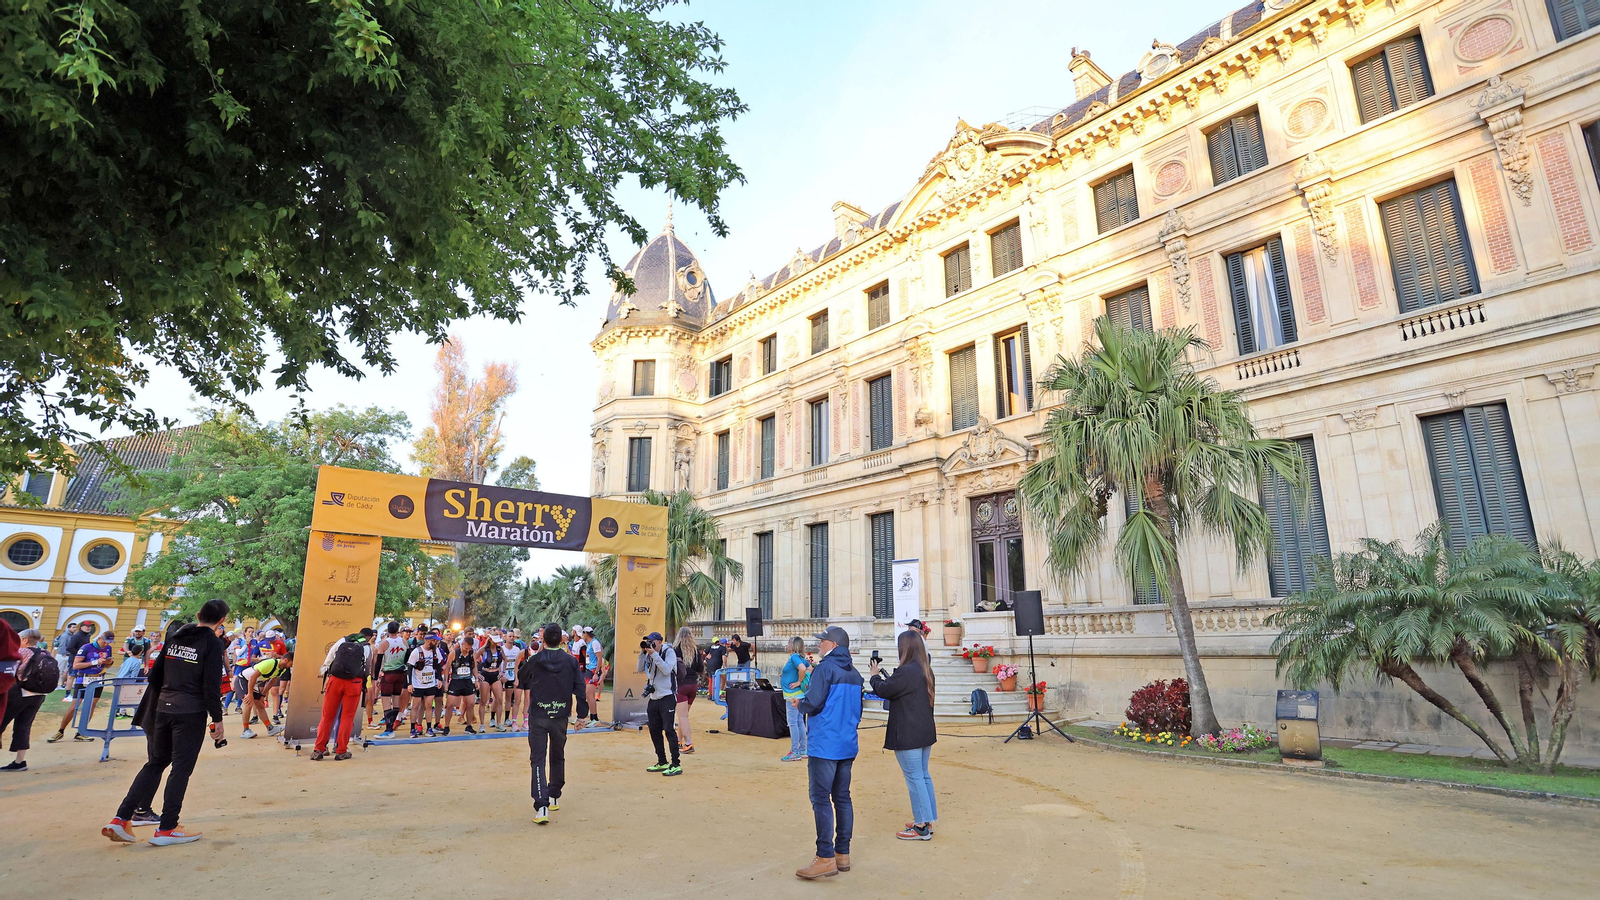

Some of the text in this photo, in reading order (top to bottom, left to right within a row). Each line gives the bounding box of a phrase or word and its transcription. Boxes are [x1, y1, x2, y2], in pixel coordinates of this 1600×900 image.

[347, 493, 380, 503] Diputación
[356, 502, 374, 510] Cádiz
[443, 487, 577, 541] Sherry
[465, 520, 555, 544] Maratón
[327, 594, 352, 602] HSN
[166, 648, 198, 660] PALACIEGO
